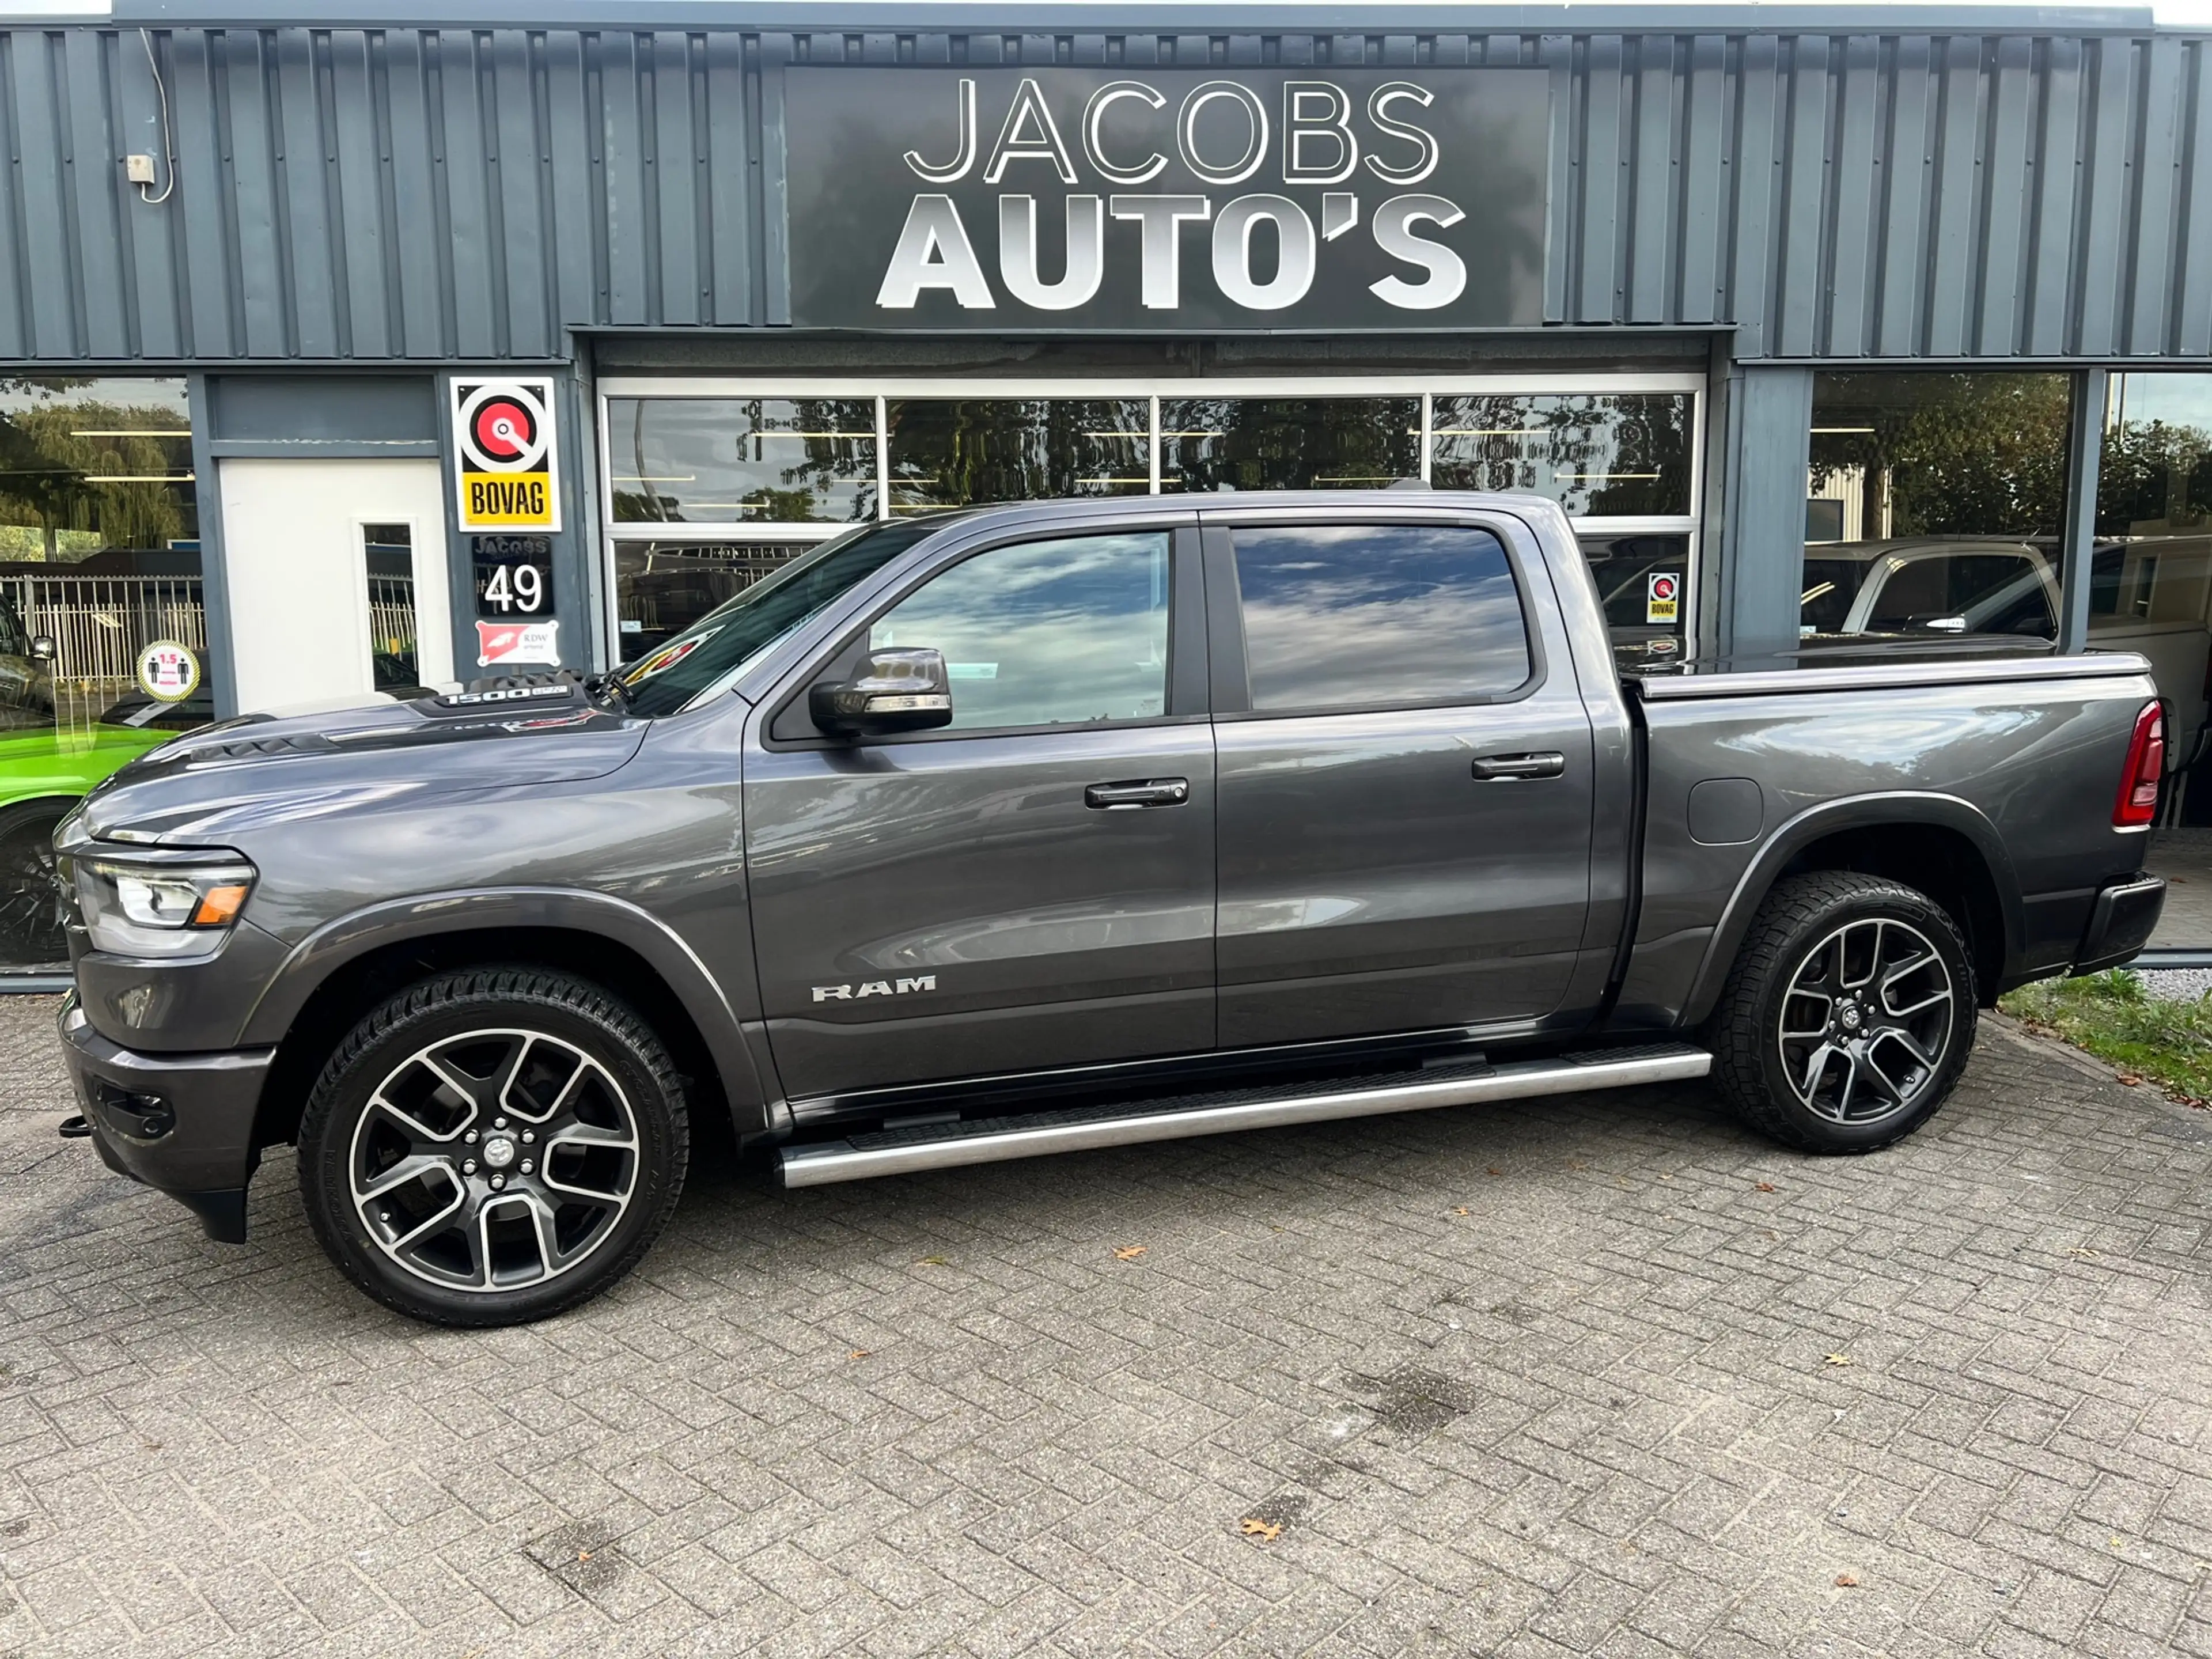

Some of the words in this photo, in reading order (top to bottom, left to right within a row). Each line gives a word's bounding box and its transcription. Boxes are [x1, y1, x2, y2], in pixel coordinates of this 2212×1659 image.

[903, 78, 1439, 184] JACOBS
[875, 193, 1467, 310] AUTO'S
[471, 482, 544, 514] BOVAG
[485, 564, 542, 612] 49
[1652, 603, 1674, 615] BOVAG
[524, 634, 548, 642] RDW
[159, 653, 177, 664] 1.5
[446, 688, 531, 705] 1500
[811, 975, 936, 1002] RAM
